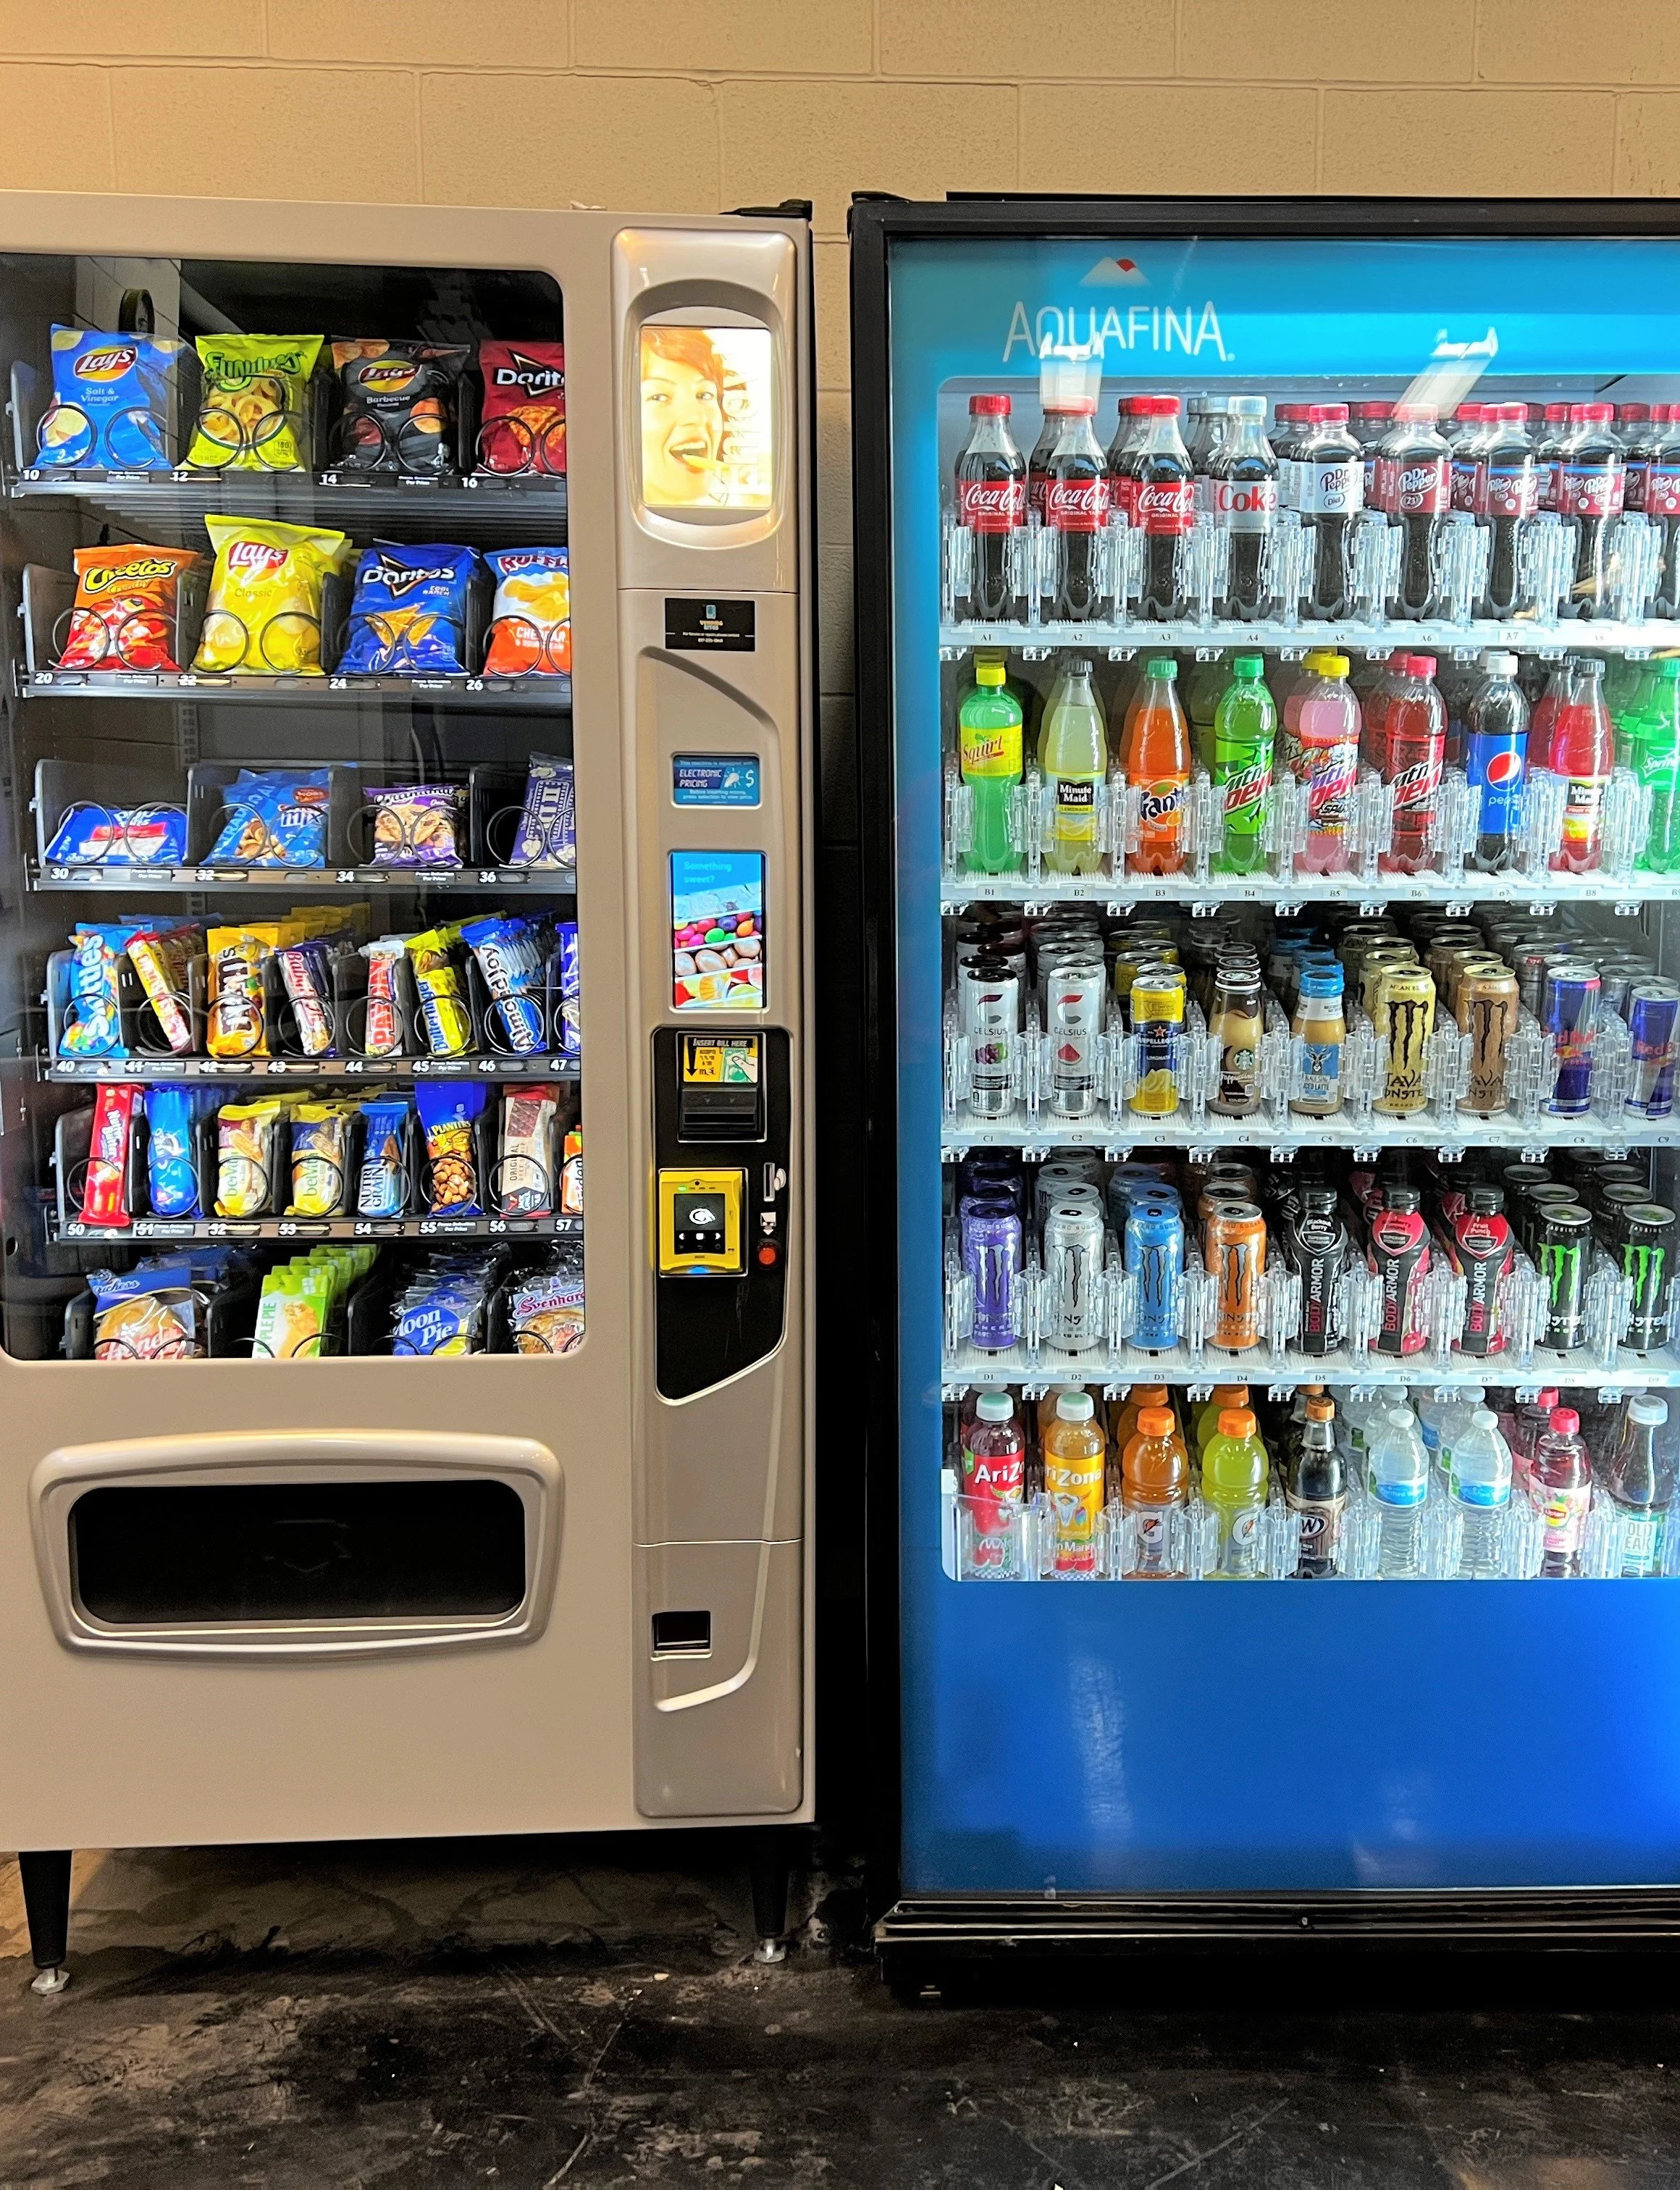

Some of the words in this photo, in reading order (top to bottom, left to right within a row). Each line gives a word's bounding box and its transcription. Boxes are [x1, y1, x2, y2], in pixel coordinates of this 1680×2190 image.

[1002, 301, 1227, 363] AQUAFINA
[81, 395, 119, 404] Vinegar
[366, 395, 411, 404] Barbecue
[23, 469, 40, 480] 10
[322, 474, 337, 484] 14
[462, 477, 478, 488] 16
[1400, 471, 1436, 492] Pepper
[84, 559, 177, 594] Cheetos
[362, 566, 455, 585] Doritos
[234, 587, 272, 597] Classic
[1333, 634, 1345, 642] A5
[1421, 634, 1432, 642] A6
[1506, 632, 1519, 641] A7
[35, 672, 54, 684] 20
[329, 678, 347, 689] 24
[466, 679, 484, 691] 26
[962, 735, 1004, 765] Squirt
[1645, 757, 1676, 771] Sprit
[1059, 784, 1092, 795] Minute
[1064, 794, 1088, 802] Maid
[1140, 788, 1185, 821] Fant
[684, 861, 732, 872] Something
[51, 868, 70, 880] 30
[337, 871, 354, 882] 34
[479, 871, 497, 883] 36
[974, 1026, 1008, 1035] CELSIUS
[1054, 1026, 1087, 1036] CELSIUS
[57, 1061, 75, 1073] 40
[345, 1061, 363, 1072] 44
[412, 1061, 429, 1072] 45
[479, 1060, 496, 1072] 46
[550, 1060, 568, 1071] 47
[1387, 1070, 1422, 1088] JAVA
[1471, 1070, 1503, 1087] AVA
[1384, 1088, 1424, 1099] ONSTE
[433, 1120, 472, 1136] PLANTERS
[509, 1143, 519, 1181] ORIGIAL
[361, 1167, 373, 1207] NUTRI
[371, 1167, 385, 1207] GRAIN
[68, 1224, 85, 1235] 50
[356, 1223, 371, 1234] 54
[420, 1222, 437, 1233] 55
[490, 1221, 506, 1233] 56
[555, 1219, 572, 1231] 57
[94, 1279, 140, 1294] uchess
[262, 1303, 277, 1319] PIE
[257, 1320, 274, 1353] APLE
[420, 1323, 453, 1347] Pie
[975, 1463, 1025, 1484] AriZo
[1047, 1468, 1103, 1487] riZona
[1628, 1522, 1652, 1536] OLD
[1625, 1536, 1651, 1551] EAK
